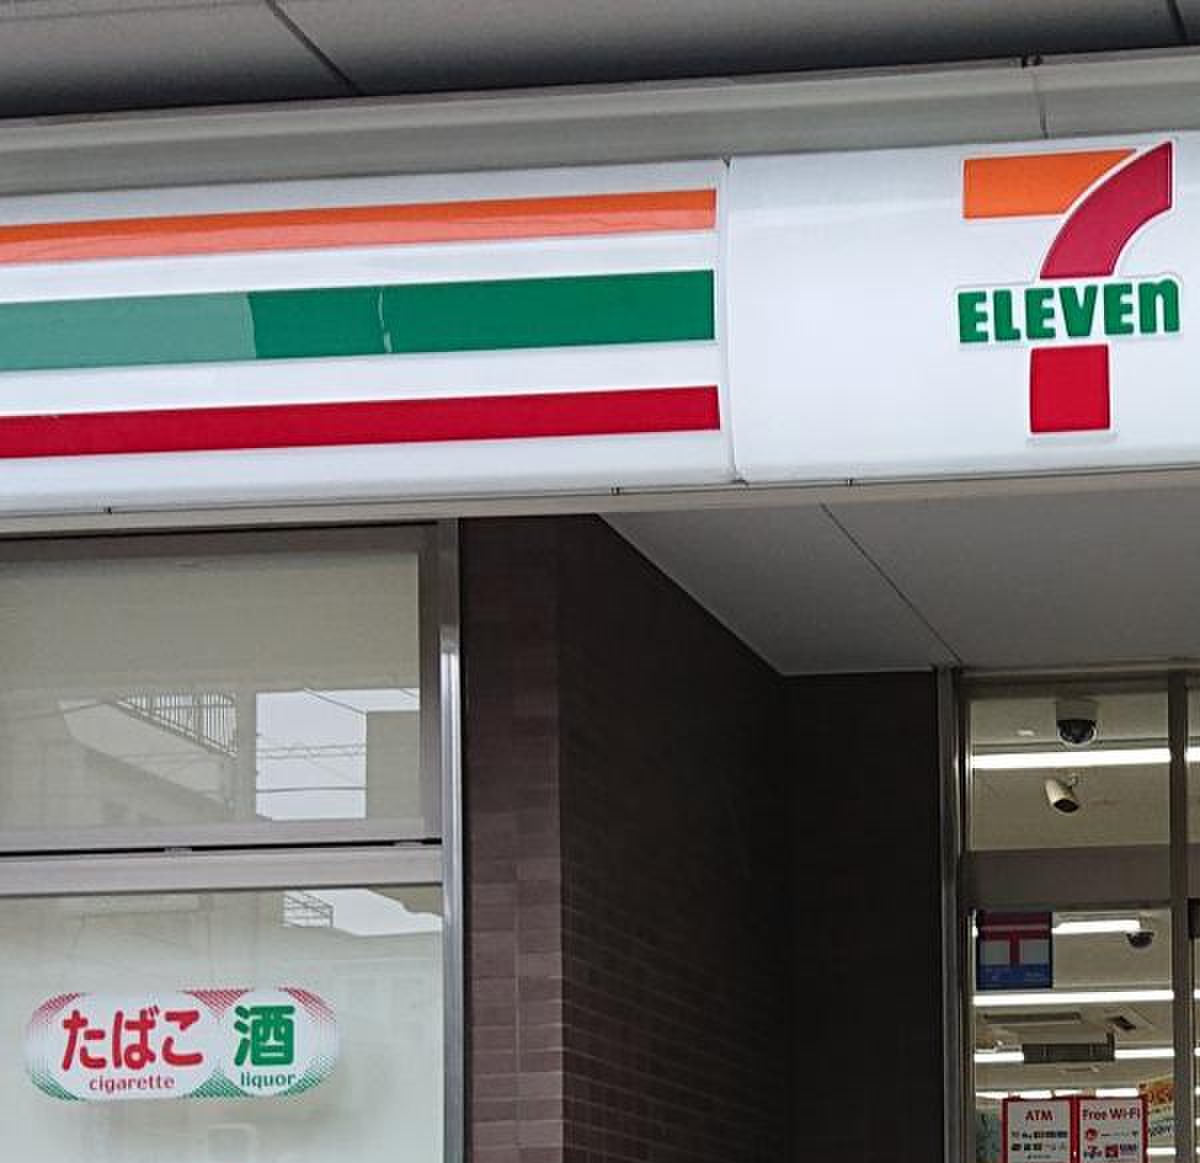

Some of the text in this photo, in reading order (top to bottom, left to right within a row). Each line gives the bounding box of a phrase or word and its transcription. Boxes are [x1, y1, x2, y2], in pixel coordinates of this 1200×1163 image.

[61, 1005, 203, 1071] たばこ
[233, 1004, 296, 1067] 酒
[88, 1074, 176, 1092] cigarette
[240, 1070, 297, 1089] liquor
[1025, 1109, 1054, 1121] ATM
[1082, 1108, 1109, 1121] Free
